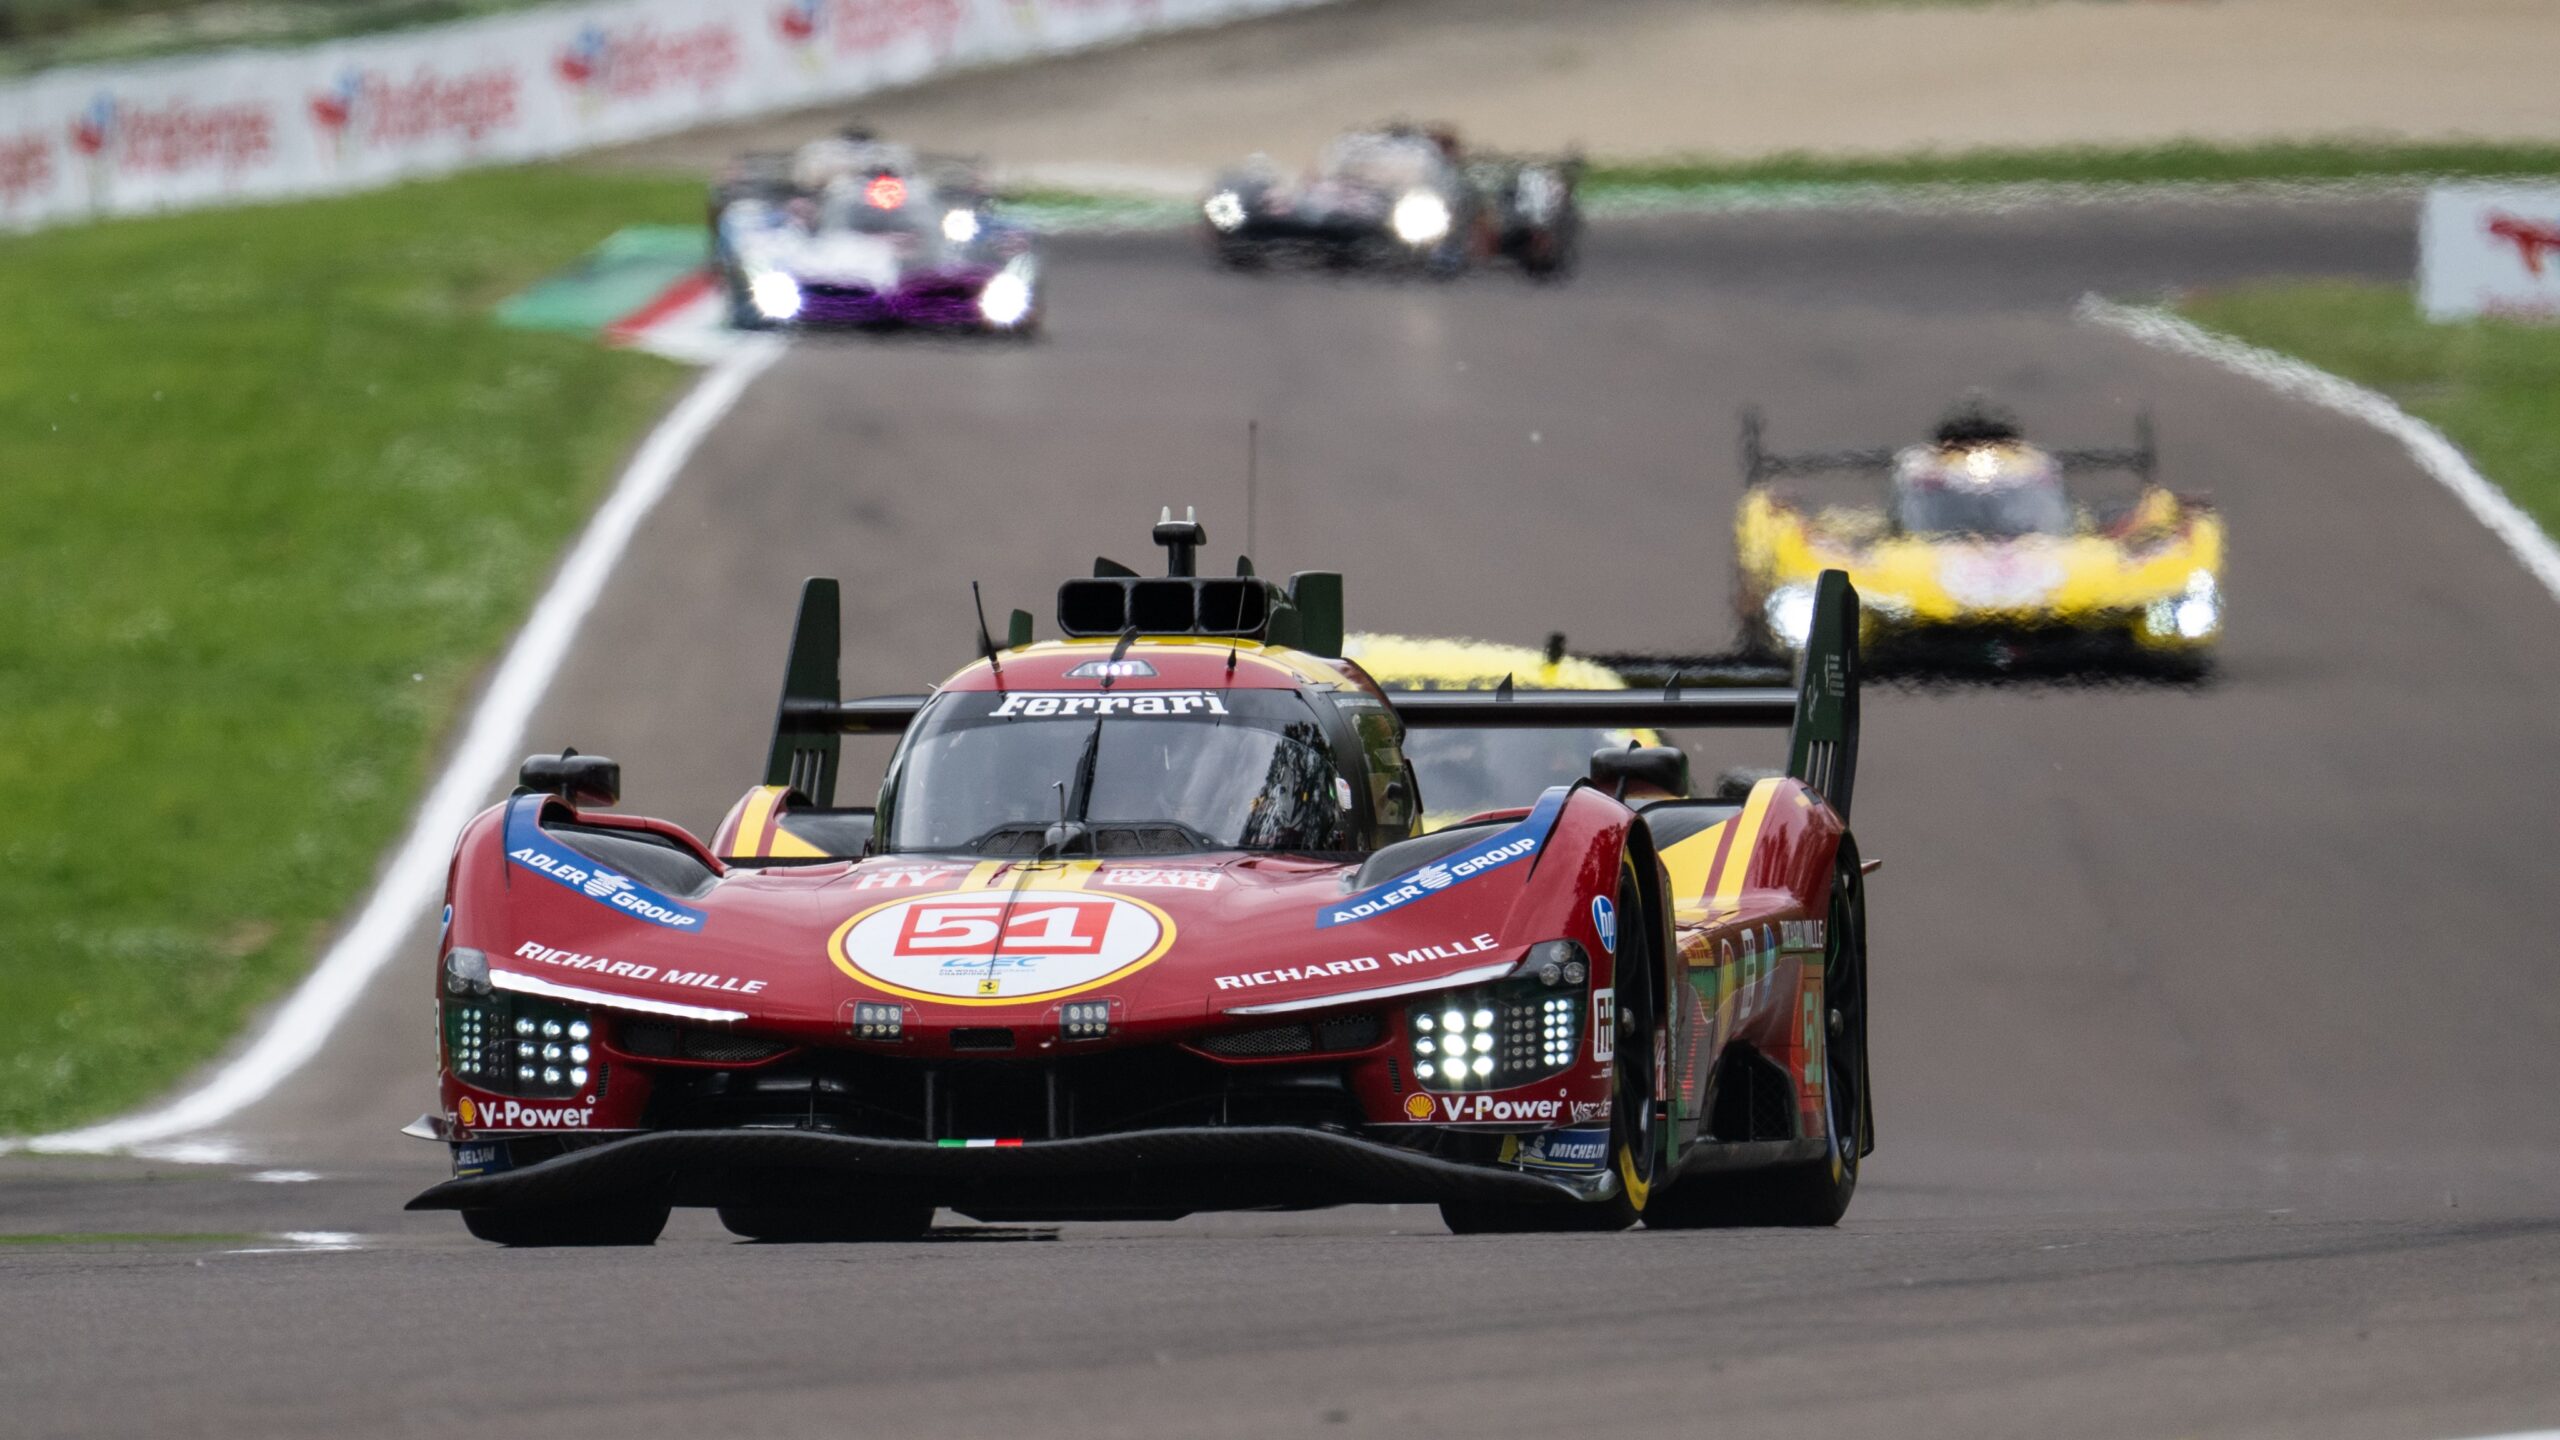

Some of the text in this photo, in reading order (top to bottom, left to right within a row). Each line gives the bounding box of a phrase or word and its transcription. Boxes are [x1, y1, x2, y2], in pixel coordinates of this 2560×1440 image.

[988, 691, 1230, 717] Ferrari
[509, 847, 697, 926] ADLER GROUP
[856, 869, 949, 890] HY
[1333, 837, 1536, 923] ADLER GROUP
[908, 906, 1095, 949] 51
[1597, 897, 1615, 949] hp
[513, 940, 768, 994] RICHARD MILLE
[1213, 933, 1499, 990] RICHARD MILLE
[478, 1101, 593, 1128] V-Power
[1442, 1095, 1563, 1121] V-Power
[1548, 1142, 1605, 1160] MICHELIN
